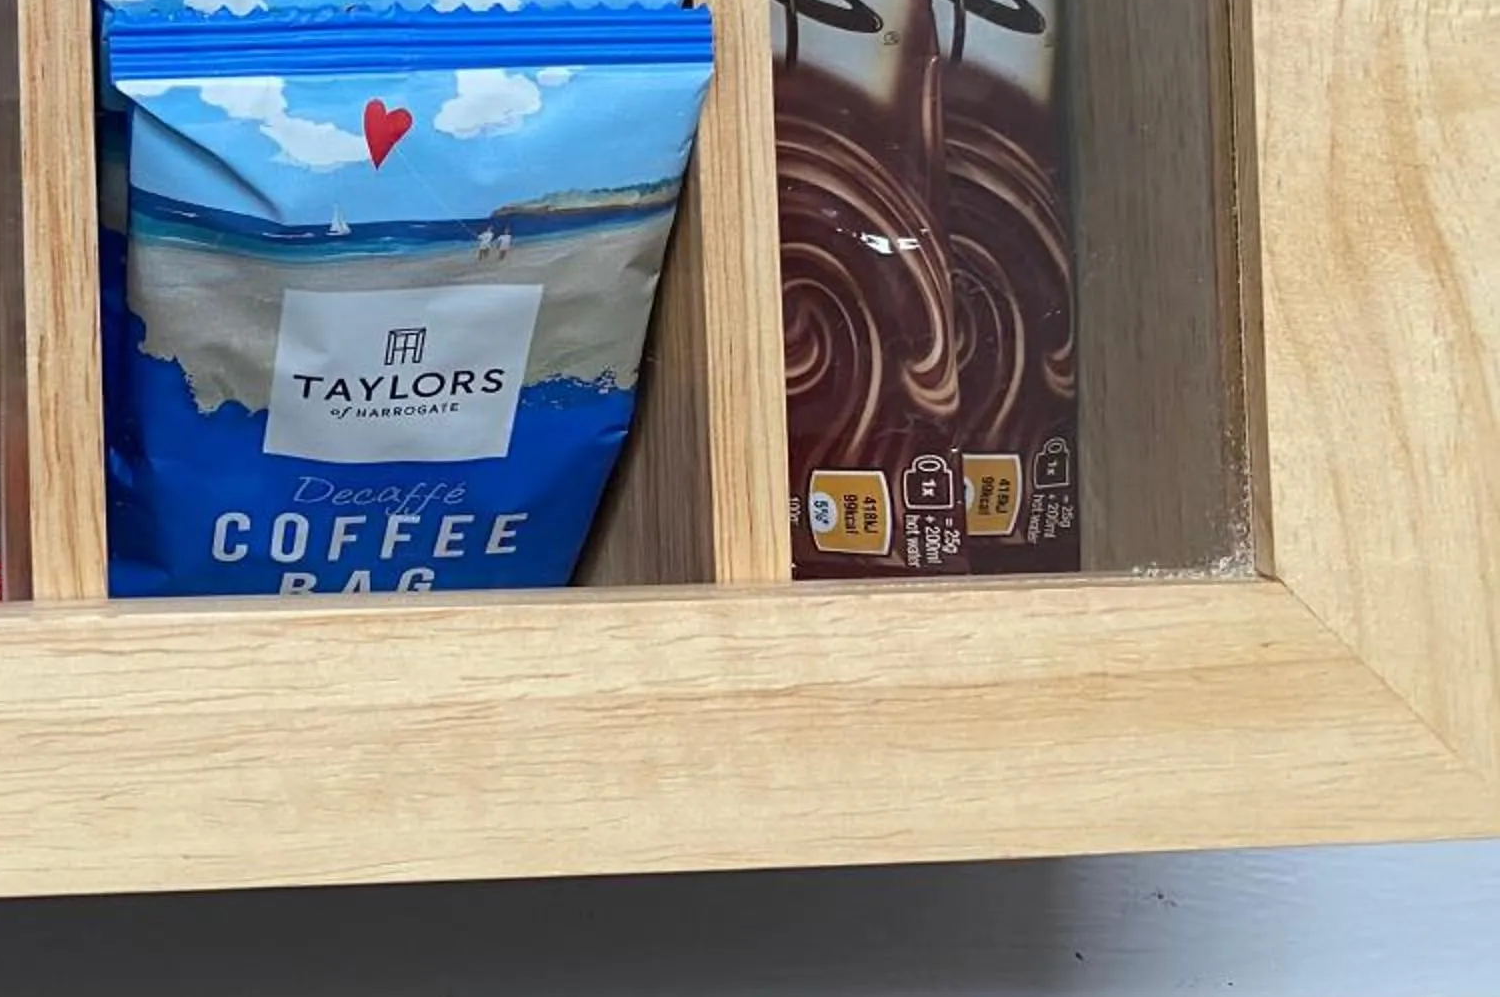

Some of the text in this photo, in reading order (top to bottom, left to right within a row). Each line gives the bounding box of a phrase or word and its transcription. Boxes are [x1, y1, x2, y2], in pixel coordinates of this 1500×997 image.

[293, 368, 505, 402] TAYLORS
[330, 403, 460, 420] of HARROGATE
[293, 476, 468, 518] Decaffé
[921, 478, 936, 497] 1x
[844, 494, 858, 535] 99kcal
[863, 496, 879, 534] 418kJ
[211, 511, 529, 563] COFFEE
[905, 514, 921, 567] hot water
[925, 526, 942, 563] 200ml
[942, 530, 961, 554] 25g
